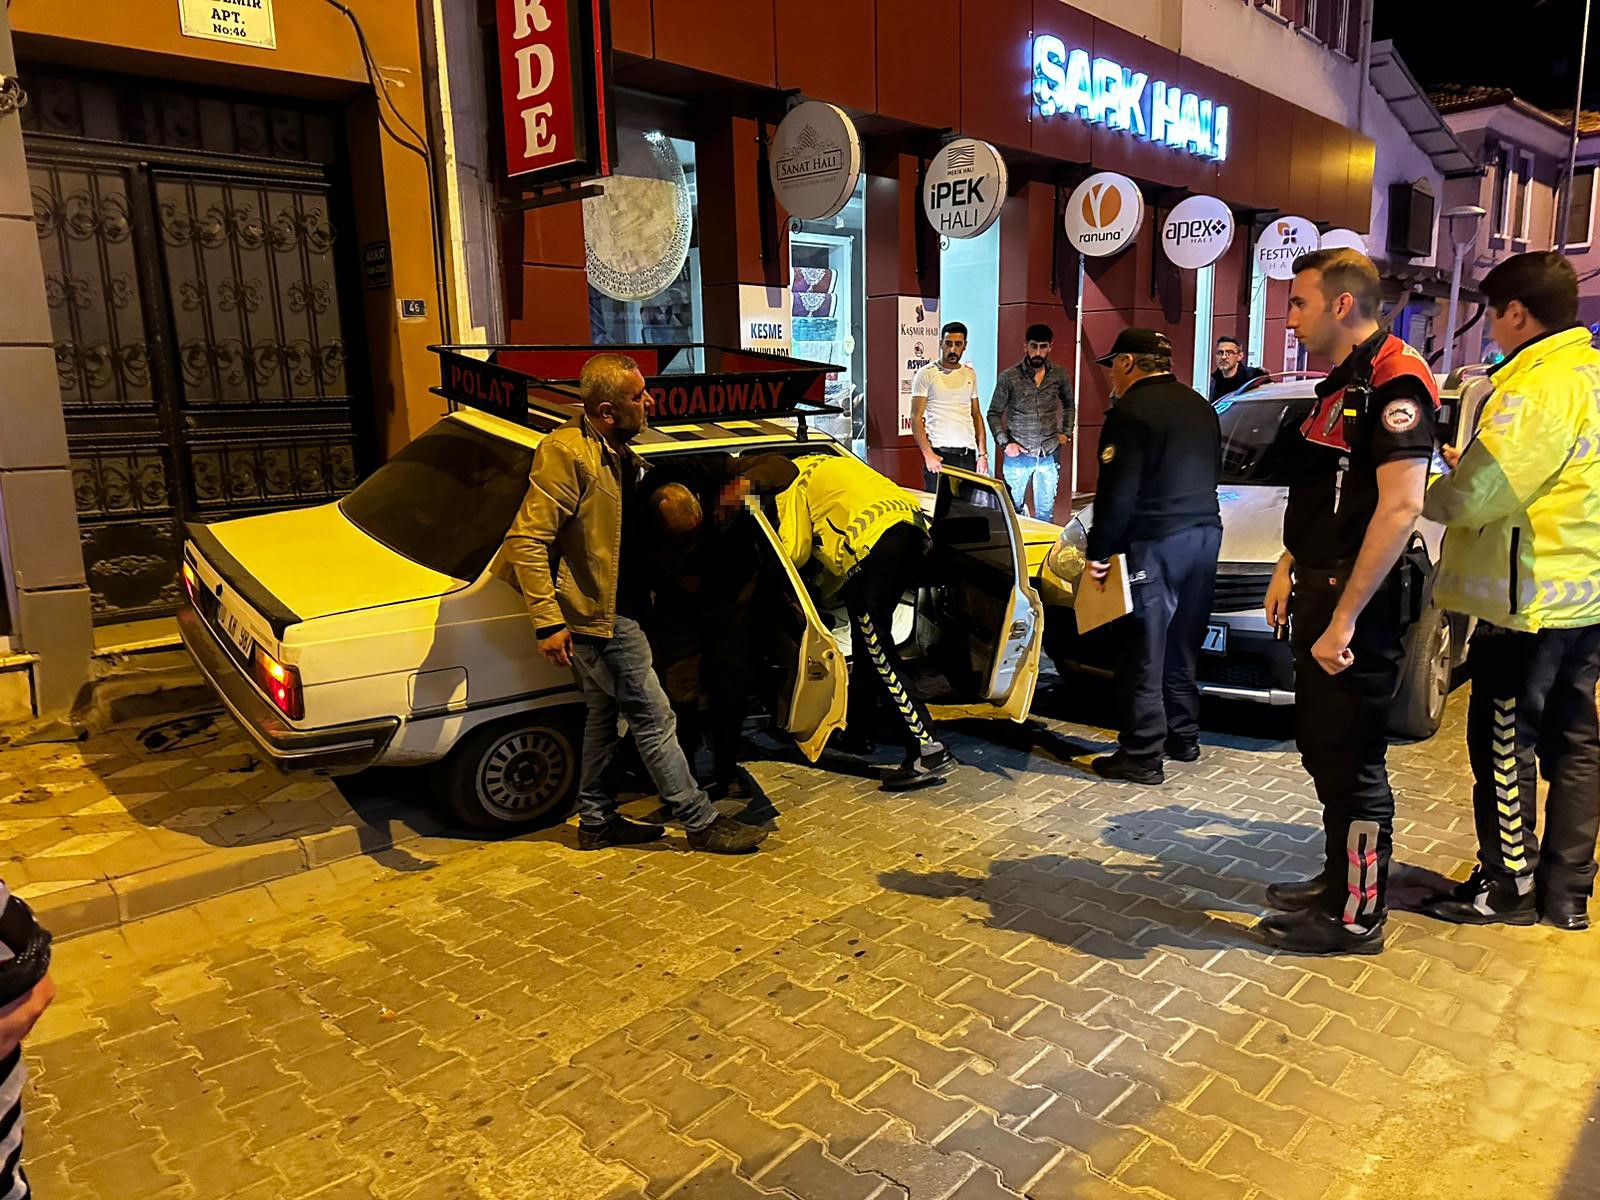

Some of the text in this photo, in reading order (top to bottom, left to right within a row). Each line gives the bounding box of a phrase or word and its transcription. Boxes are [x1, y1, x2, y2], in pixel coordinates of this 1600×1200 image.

[211, 7, 246, 25] APT.
[212, 23, 247, 38] No:46
[1032, 33, 1229, 162] ŞARK HALI
[781, 156, 837, 176] SANAT HALI
[940, 208, 979, 231] HALI
[1078, 229, 1122, 243] ranuna
[1165, 218, 1214, 246] apex
[408, 302, 421, 313] 46
[750, 322, 783, 340] KESME
[451, 366, 513, 408] POLAT
[649, 381, 784, 417] ROADWAY
